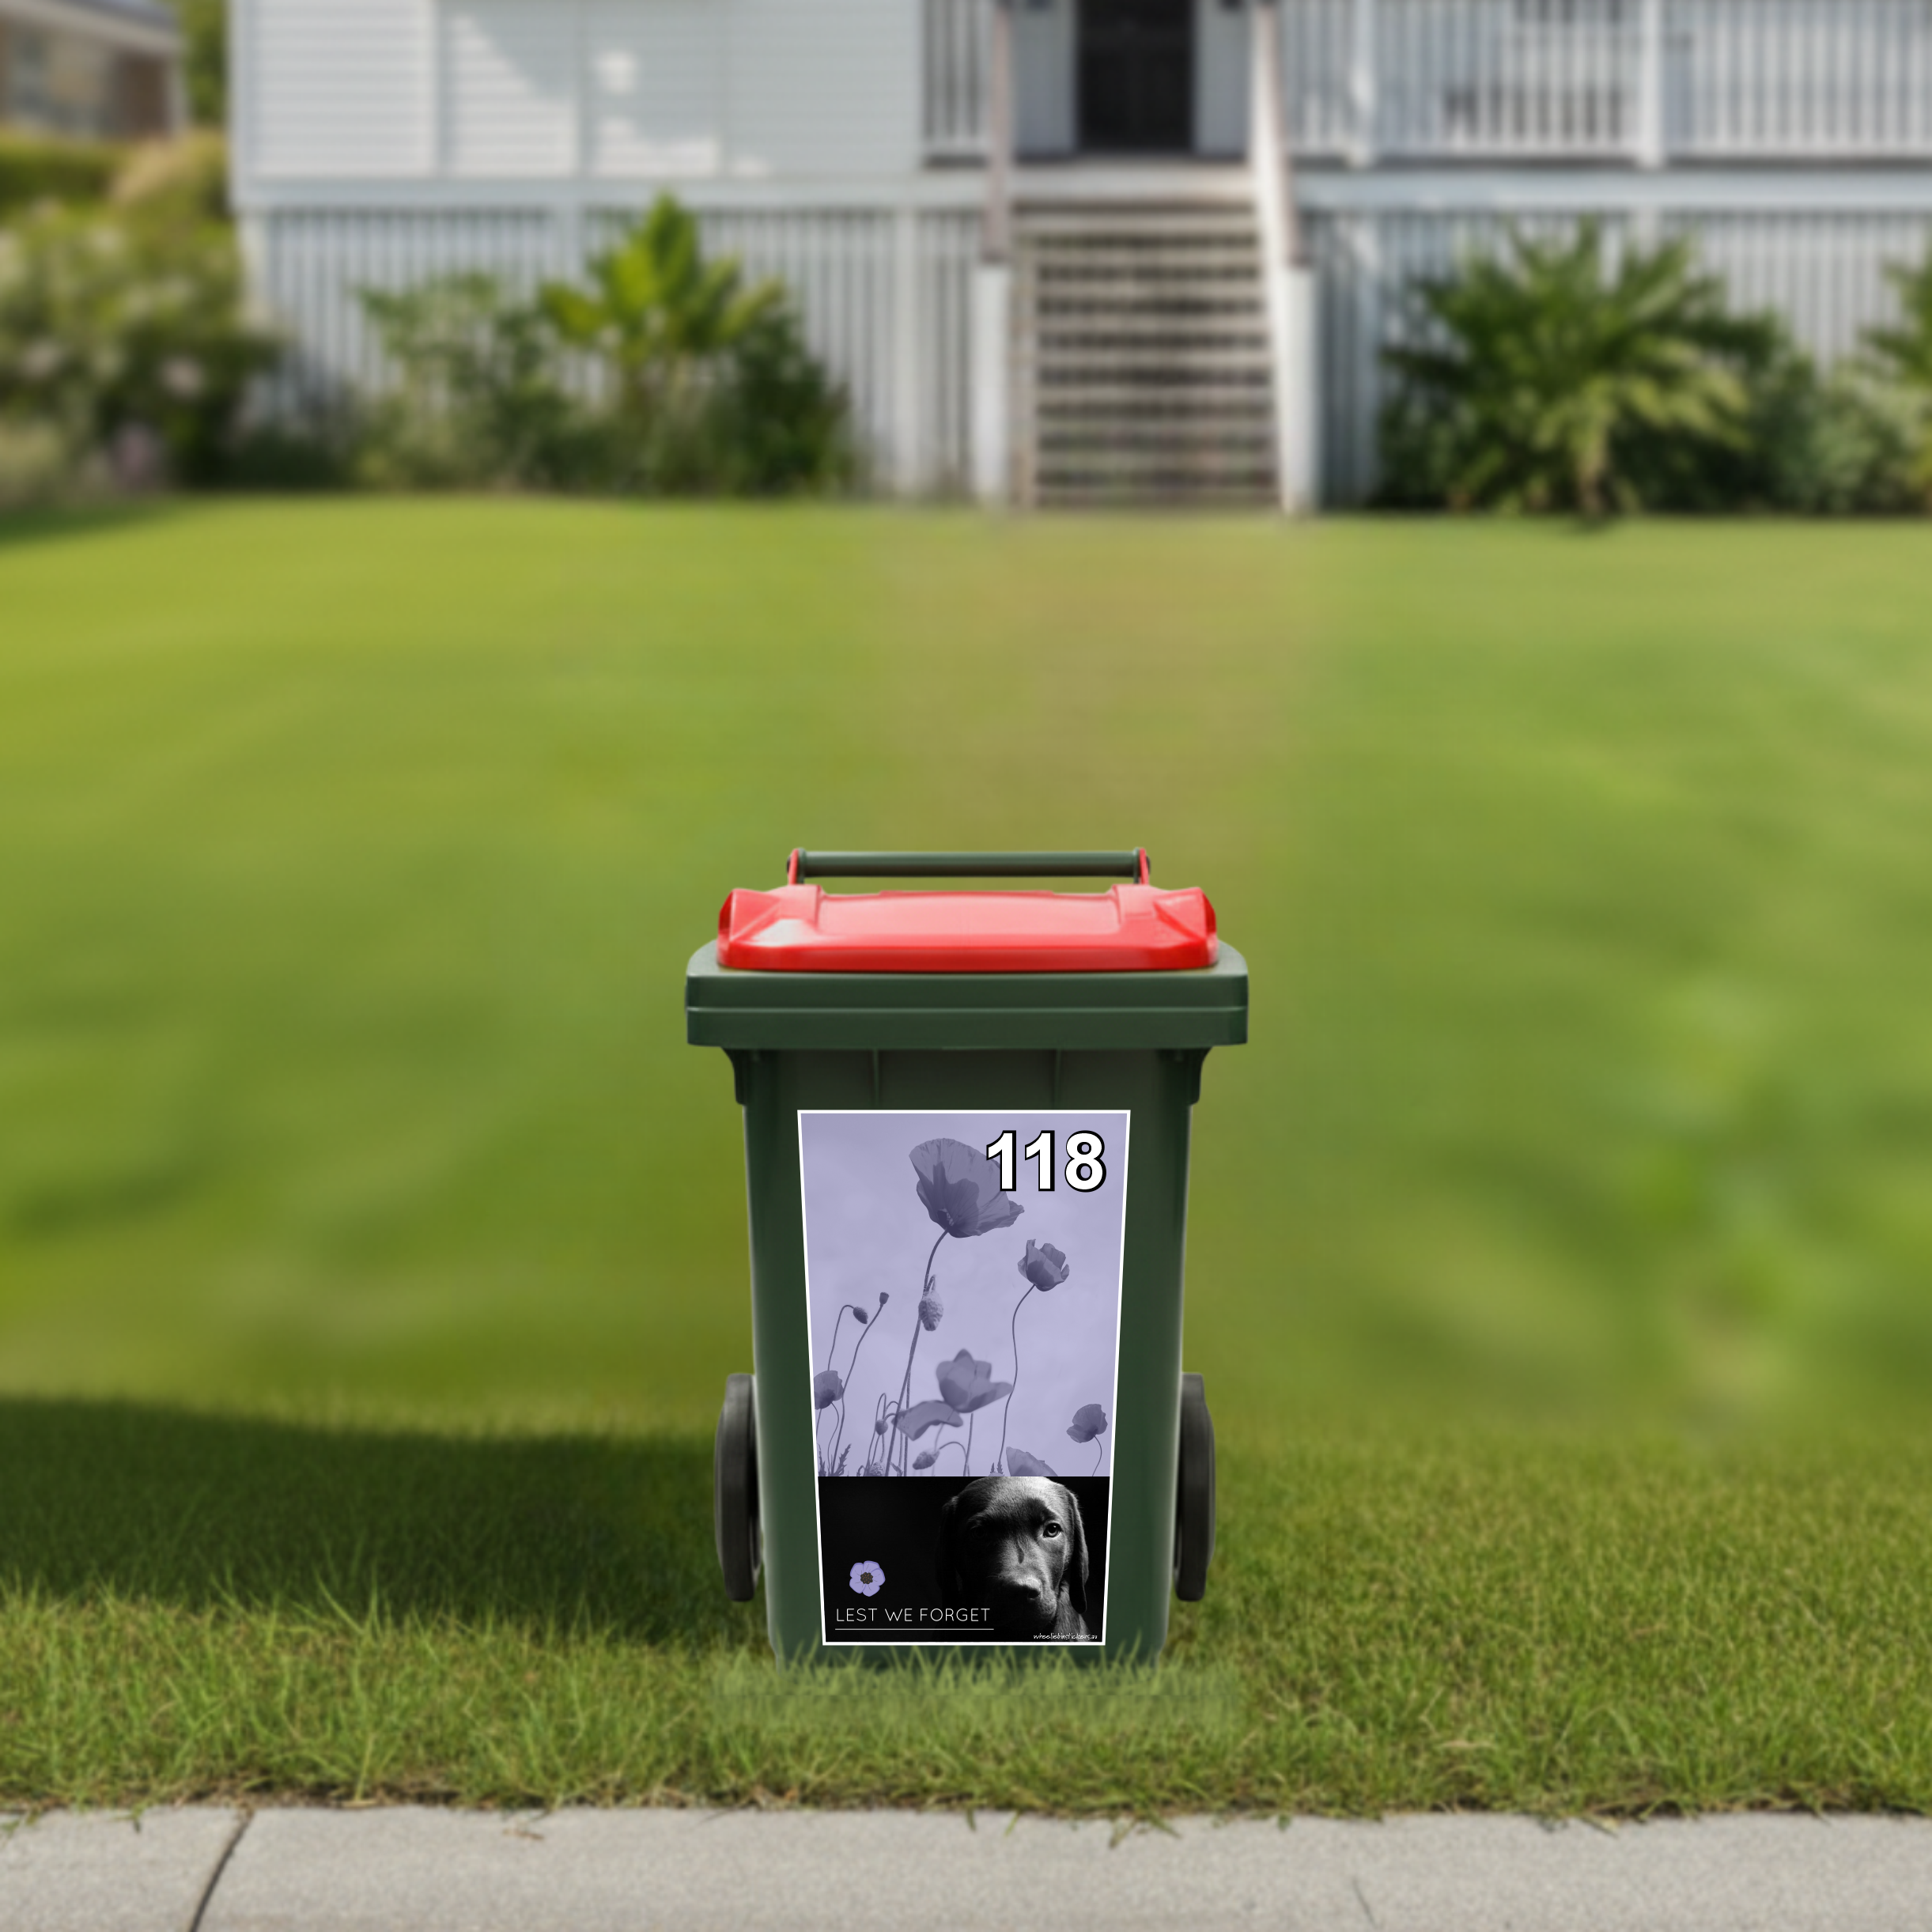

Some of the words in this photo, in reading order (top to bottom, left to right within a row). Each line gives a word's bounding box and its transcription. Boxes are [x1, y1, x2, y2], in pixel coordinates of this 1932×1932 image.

[986, 1130, 1106, 1192] 118
[836, 1608, 878, 1621] LEST
[884, 1608, 913, 1621] WE
[920, 1608, 990, 1621] FORGET
